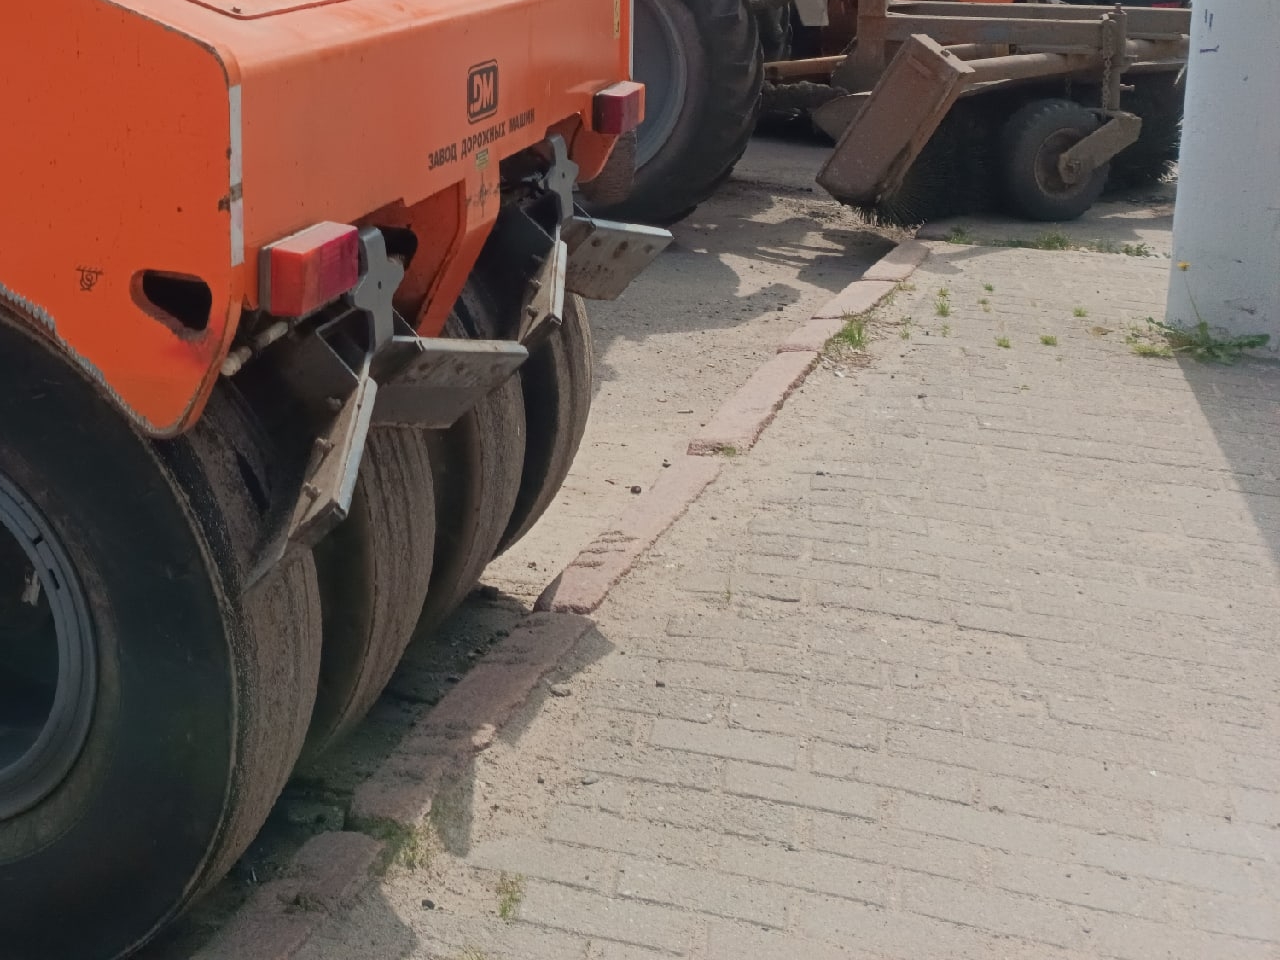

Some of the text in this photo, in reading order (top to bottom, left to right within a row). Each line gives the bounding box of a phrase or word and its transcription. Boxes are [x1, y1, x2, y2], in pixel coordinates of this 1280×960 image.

[428, 142, 458, 171] ЗАВОД
[460, 121, 506, 160] ДОРОЖНЫХ
[508, 108, 536, 134] МАШИН
